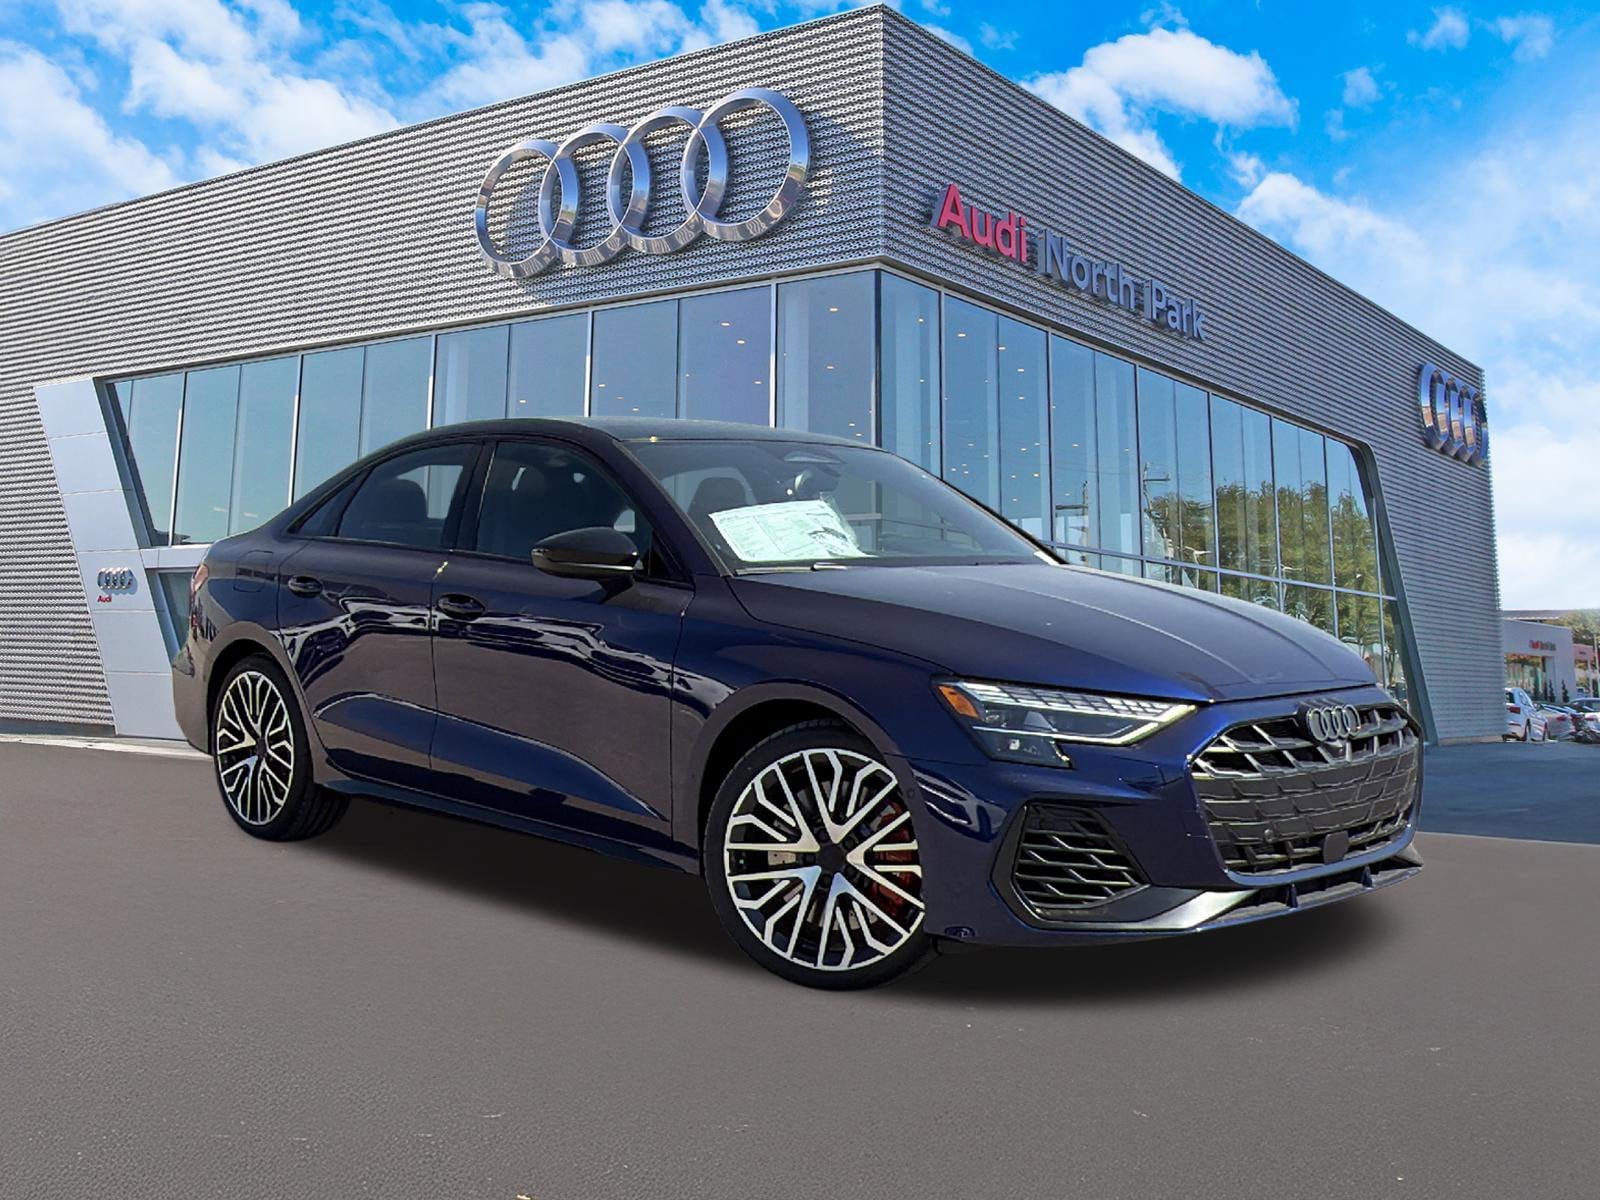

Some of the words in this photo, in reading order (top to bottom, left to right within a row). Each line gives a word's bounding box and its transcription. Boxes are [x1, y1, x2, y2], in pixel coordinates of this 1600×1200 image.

[934, 183, 1028, 263] Audi
[1037, 228, 1137, 311] North
[1143, 276, 1206, 341] Park
